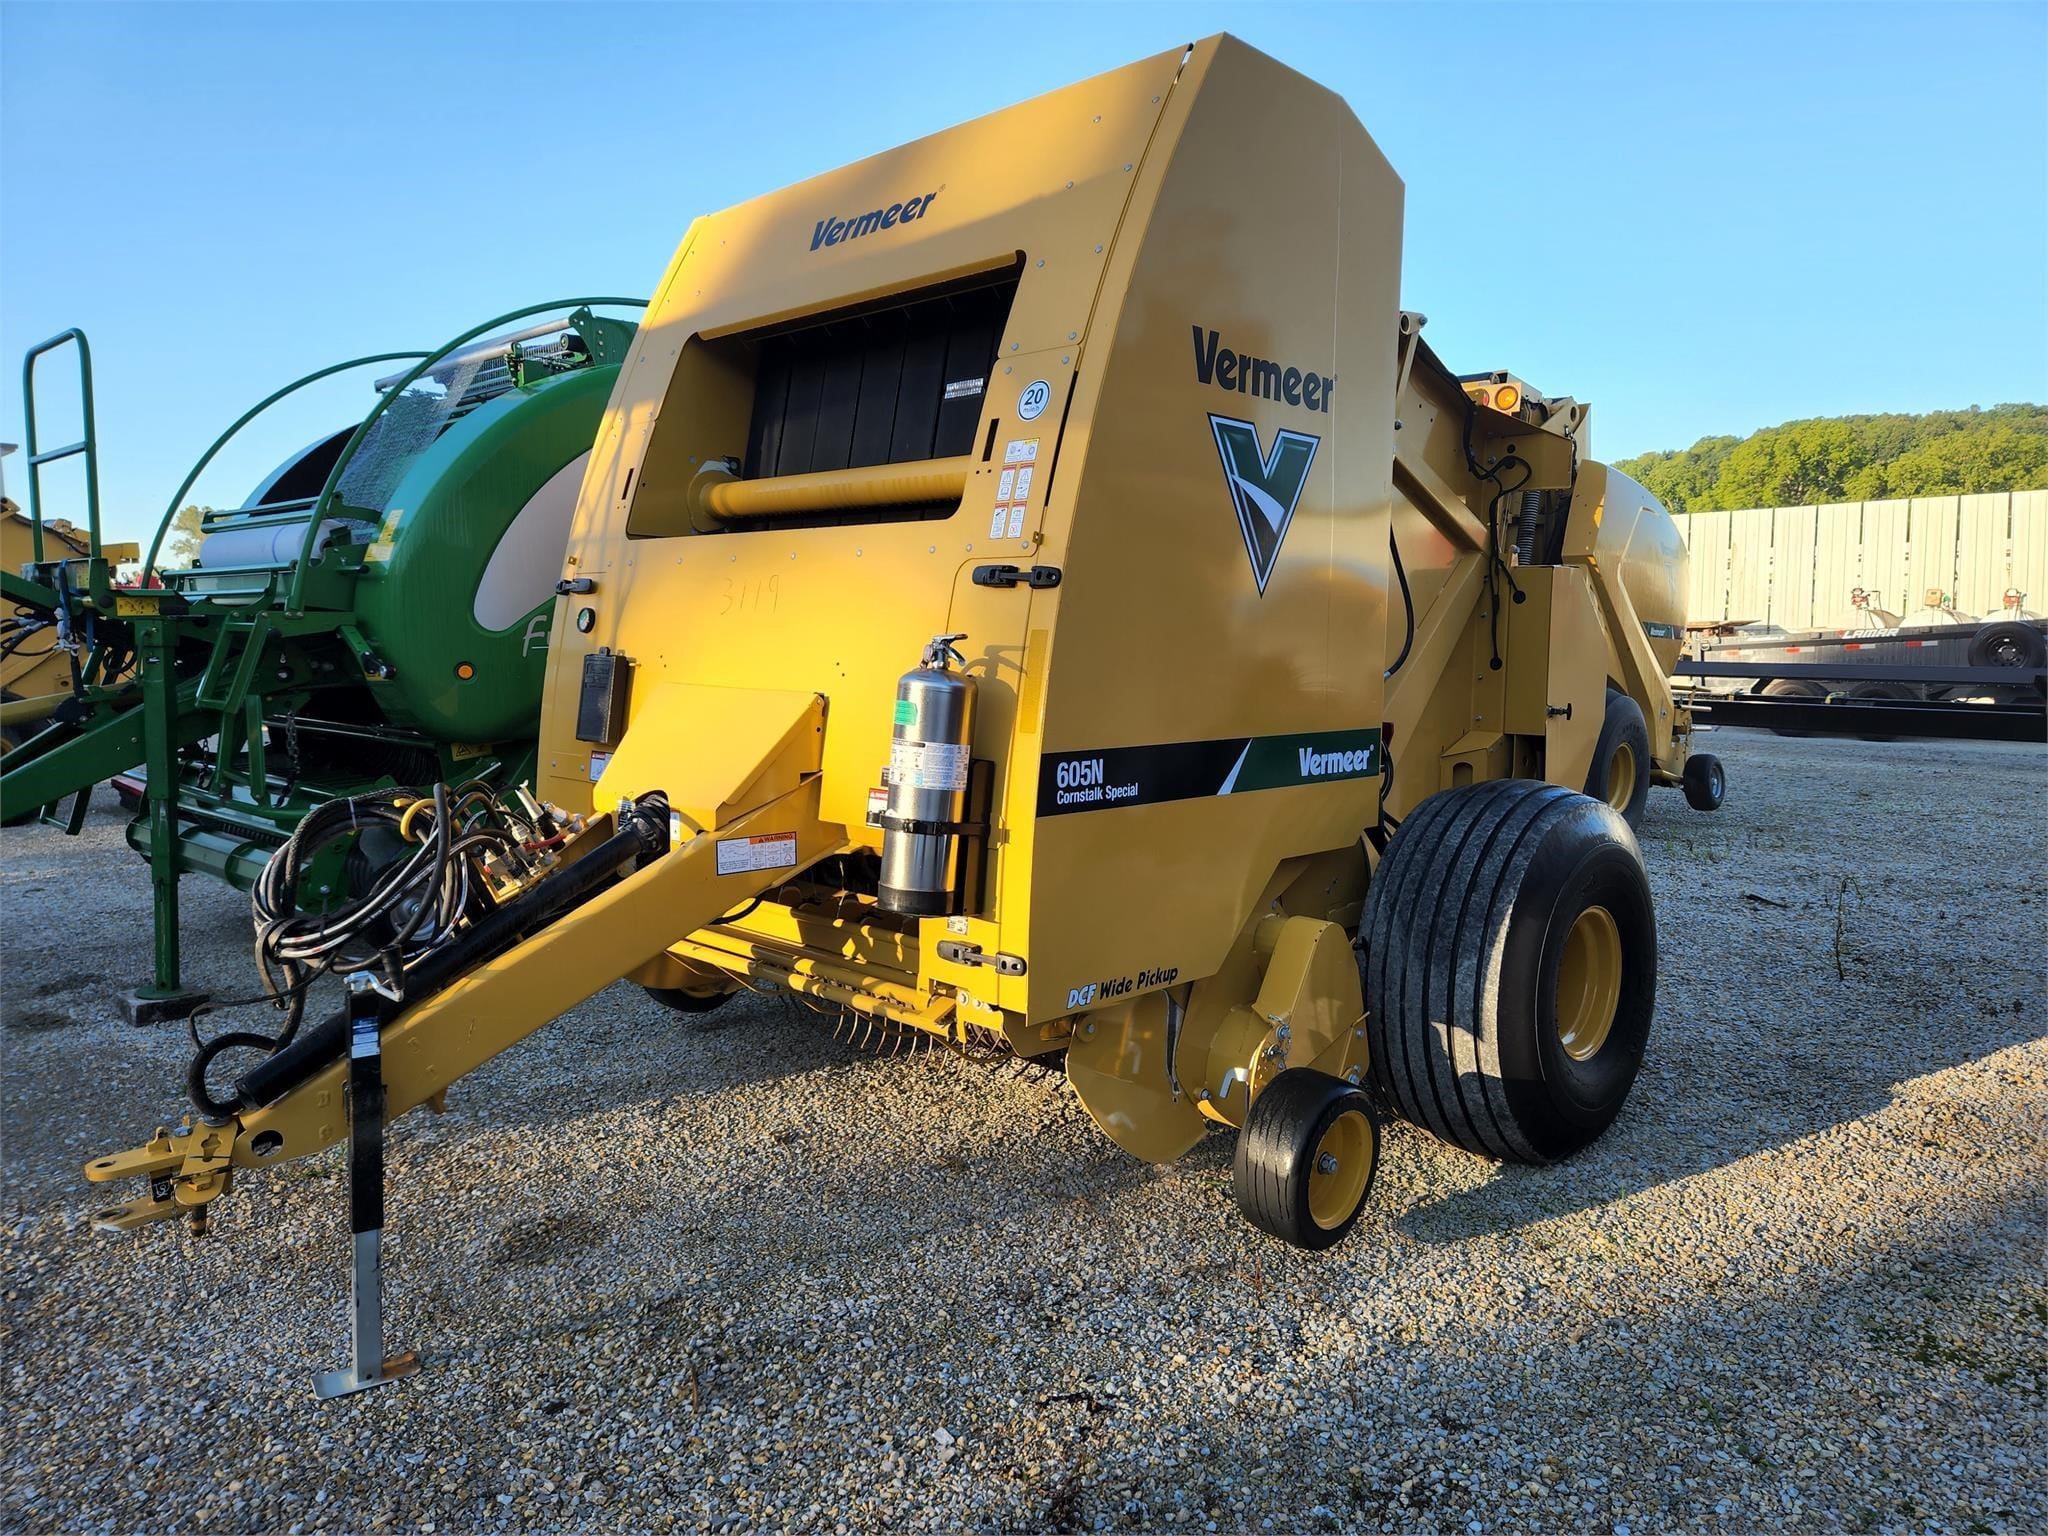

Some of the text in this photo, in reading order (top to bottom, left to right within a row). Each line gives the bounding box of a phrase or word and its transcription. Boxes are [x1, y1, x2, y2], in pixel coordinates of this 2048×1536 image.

[810, 191, 938, 251] Vermeer
[1192, 325, 1334, 413] Vermeer
[1024, 388, 1044, 406] 20
[1842, 628, 1900, 640] LAMAR
[1056, 758, 1104, 788] 605N
[1298, 747, 1370, 777] Vermeer
[1056, 782, 1139, 805] Cornstalk Special
[1066, 967, 1178, 1009] DCF Wide Pickup
